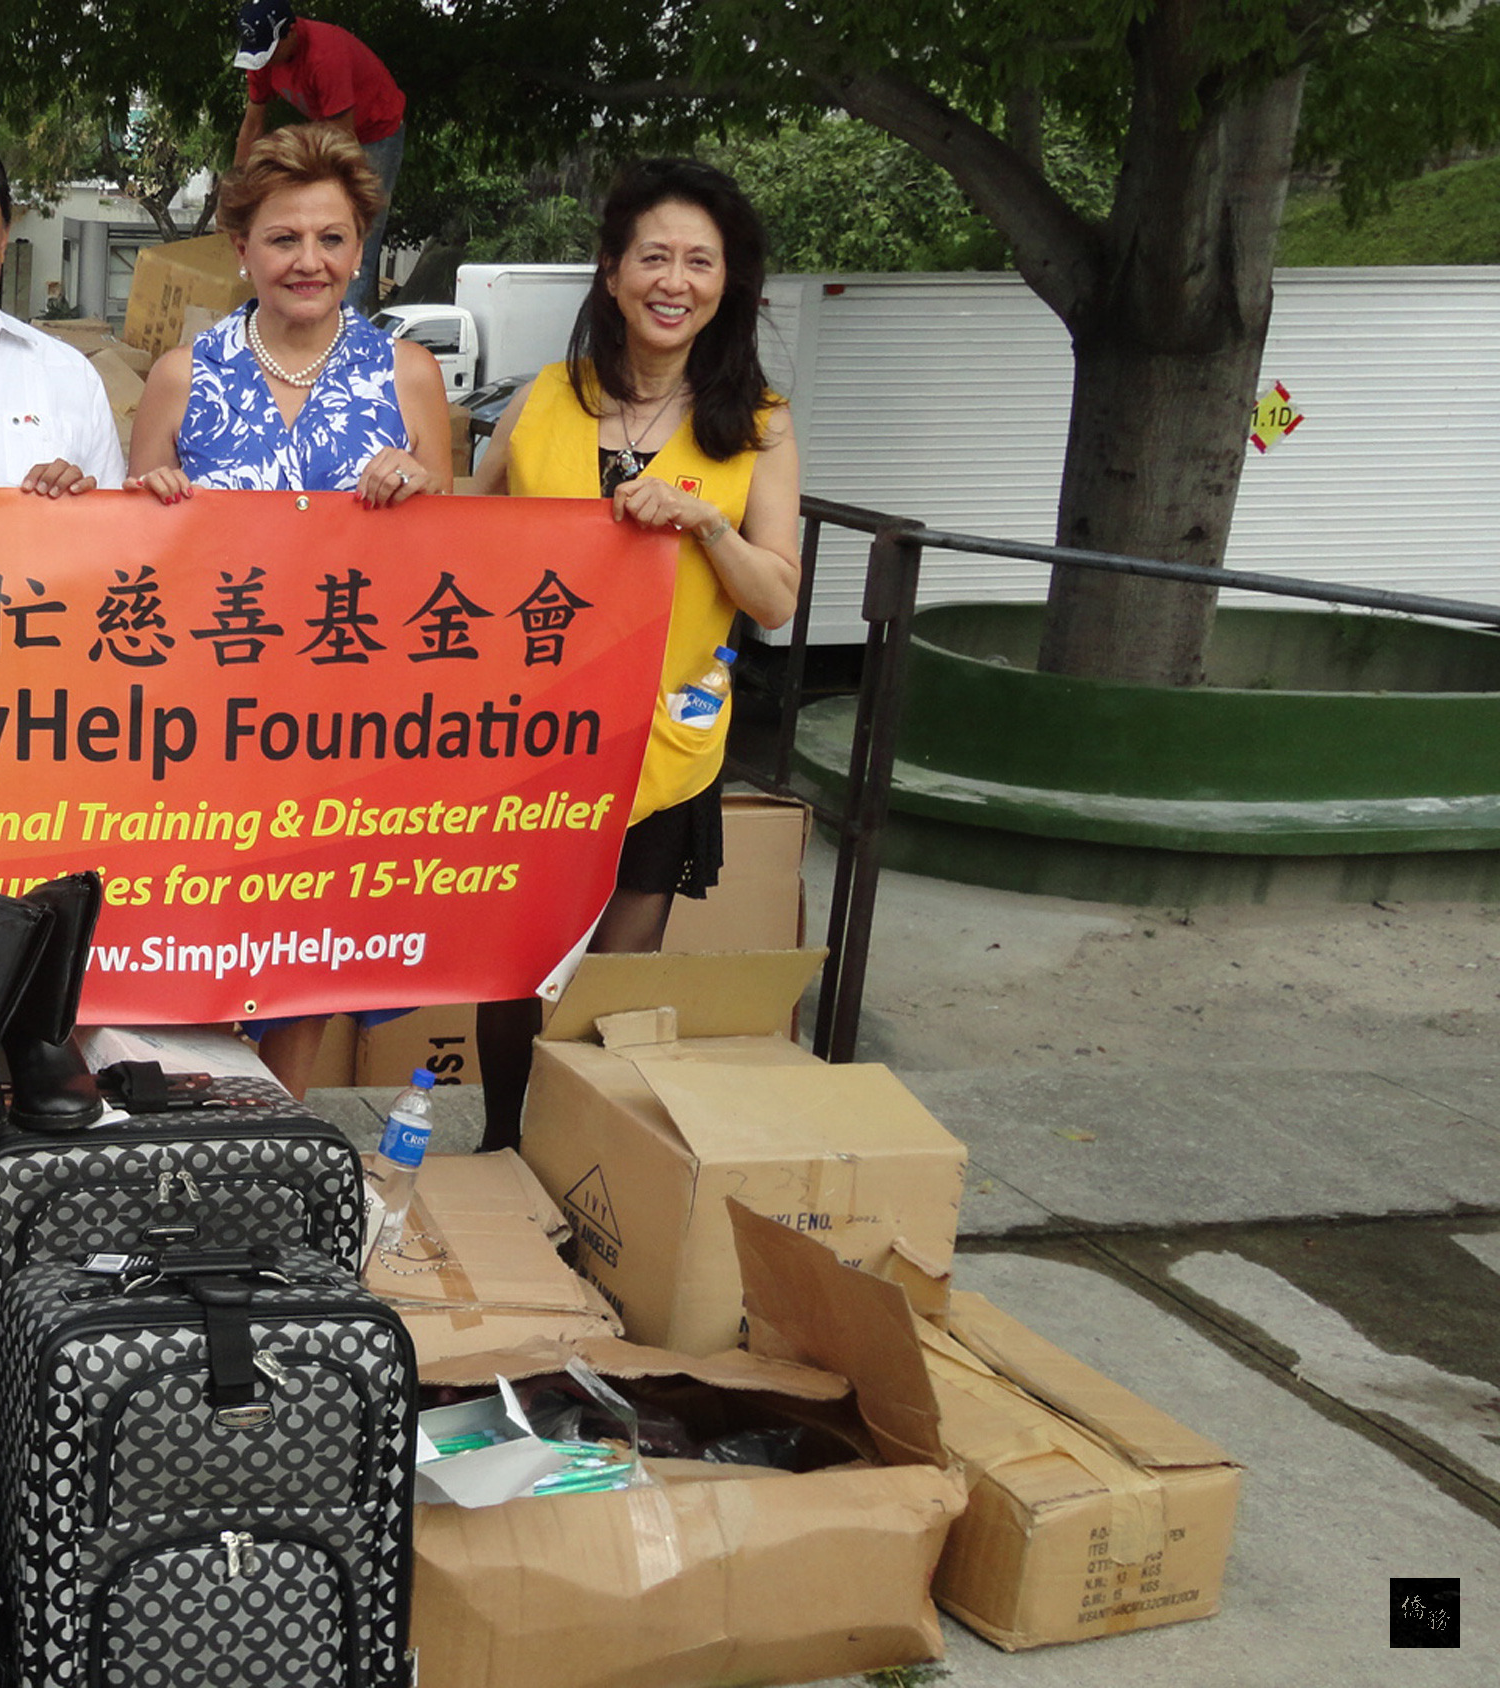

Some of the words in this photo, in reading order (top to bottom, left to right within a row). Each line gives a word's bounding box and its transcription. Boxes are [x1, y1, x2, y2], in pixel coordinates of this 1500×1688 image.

[1251, 407, 1292, 427] 1.1D
[225, 692, 601, 762] Foundation
[78, 801, 261, 851] Training
[269, 799, 303, 838] &
[312, 796, 486, 838] Disaster
[493, 791, 614, 833] Relief
[164, 863, 232, 906] for
[239, 872, 333, 903] over
[349, 857, 519, 898] 15-Years
[85, 926, 427, 980] w.SimplyHelp.org
